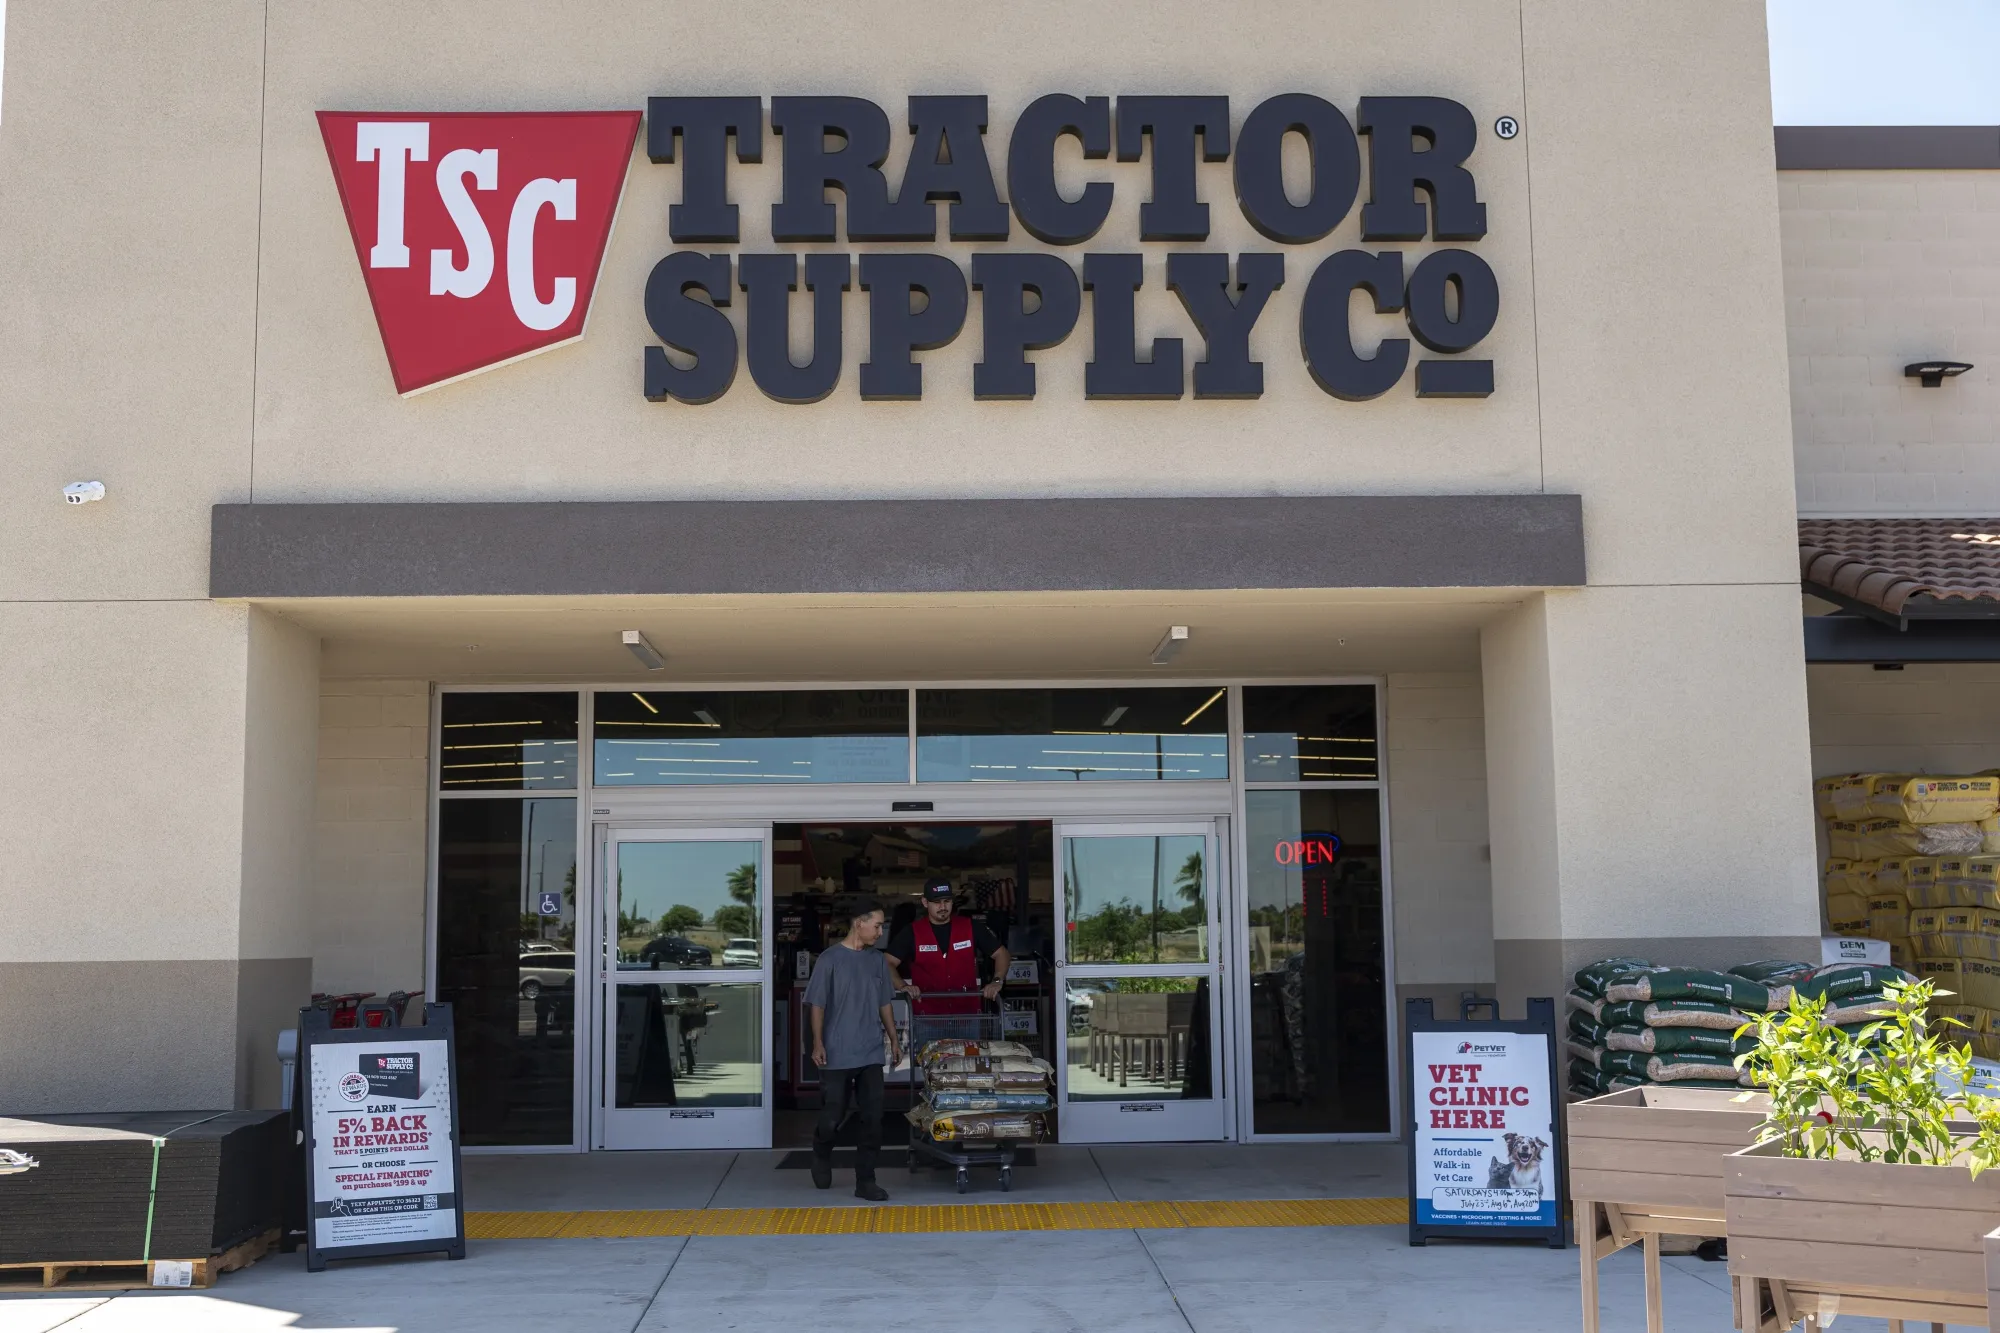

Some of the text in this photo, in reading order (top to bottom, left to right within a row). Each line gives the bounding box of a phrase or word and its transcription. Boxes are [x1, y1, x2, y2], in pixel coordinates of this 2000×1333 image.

[647, 93, 1487, 244] TRACTOR
[355, 121, 578, 331] TSC
[643, 250, 1284, 404] SUPPLY
[1275, 841, 1333, 864] OPEN
[1840, 941, 1865, 950] GEM
[1013, 970, 1031, 978] $6.49
[1428, 1064, 1482, 1083] VET
[342, 1083, 367, 1091] REWARDS
[1429, 1086, 1529, 1106] CLINIC
[367, 1104, 396, 1113] EARN
[338, 1115, 427, 1133] 5% BACK
[1430, 1110, 1505, 1129] HERE
[333, 1136, 350, 1148] IN
[1433, 1148, 1482, 1156] Affordable
[374, 1160, 406, 1168] CHOOSE
[1434, 1161, 1470, 1169] Walk-in
[335, 1173, 375, 1183] SPECIAL
[1452, 1174, 1473, 1182] Care
[353, 1181, 392, 1190] purchases
[1445, 1188, 1493, 1197] SATURDAYS
[1461, 1200, 1475, 1209] July
[1513, 1199, 1525, 1210] Aug
